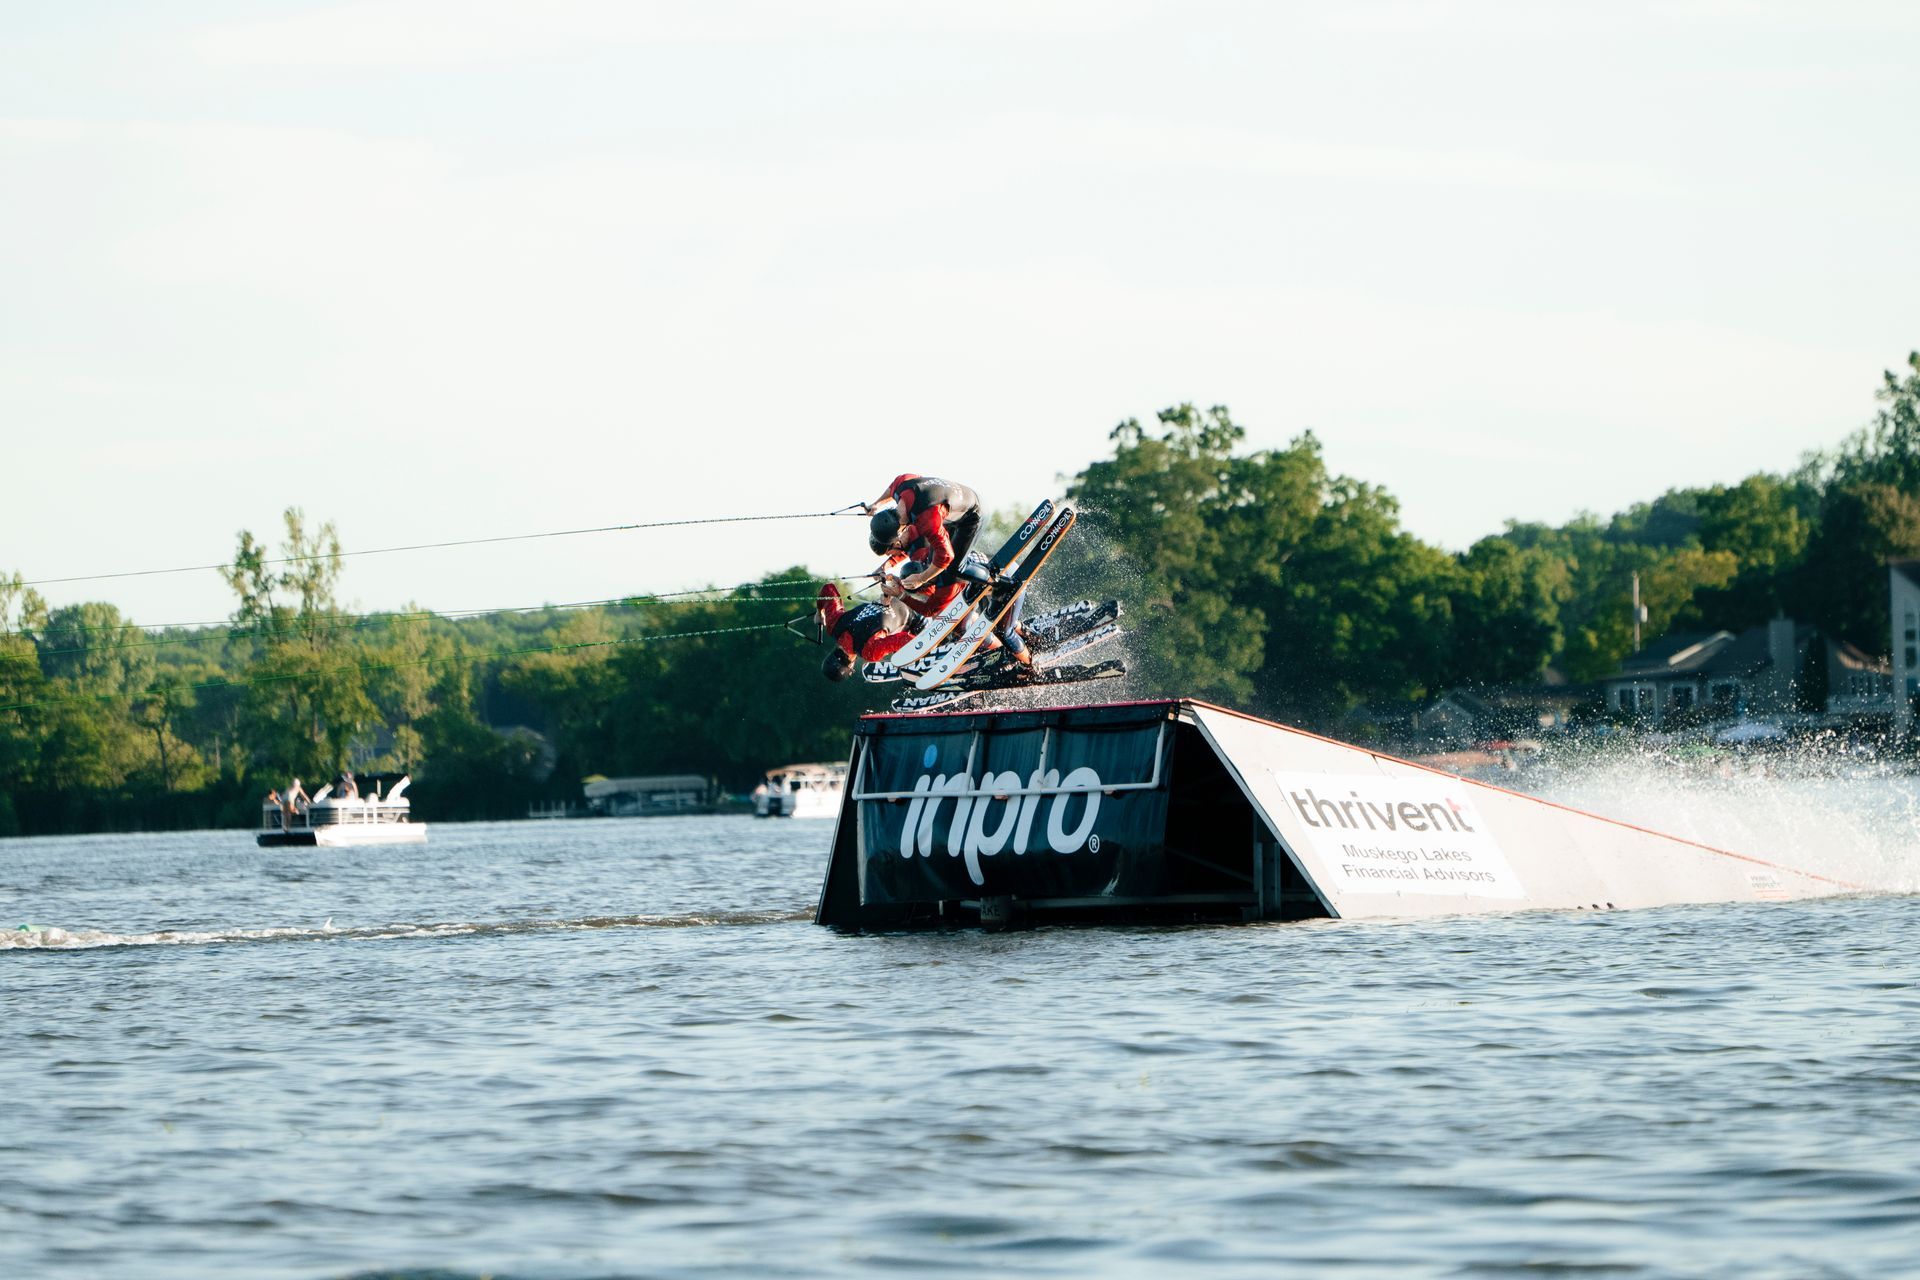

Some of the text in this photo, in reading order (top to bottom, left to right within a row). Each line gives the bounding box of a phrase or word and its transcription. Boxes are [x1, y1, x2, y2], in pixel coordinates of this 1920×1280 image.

[1290, 788, 1476, 833] thrivent
[1342, 843, 1473, 864] Muskego Lakes
[1341, 864, 1497, 883] Financial Advisors
